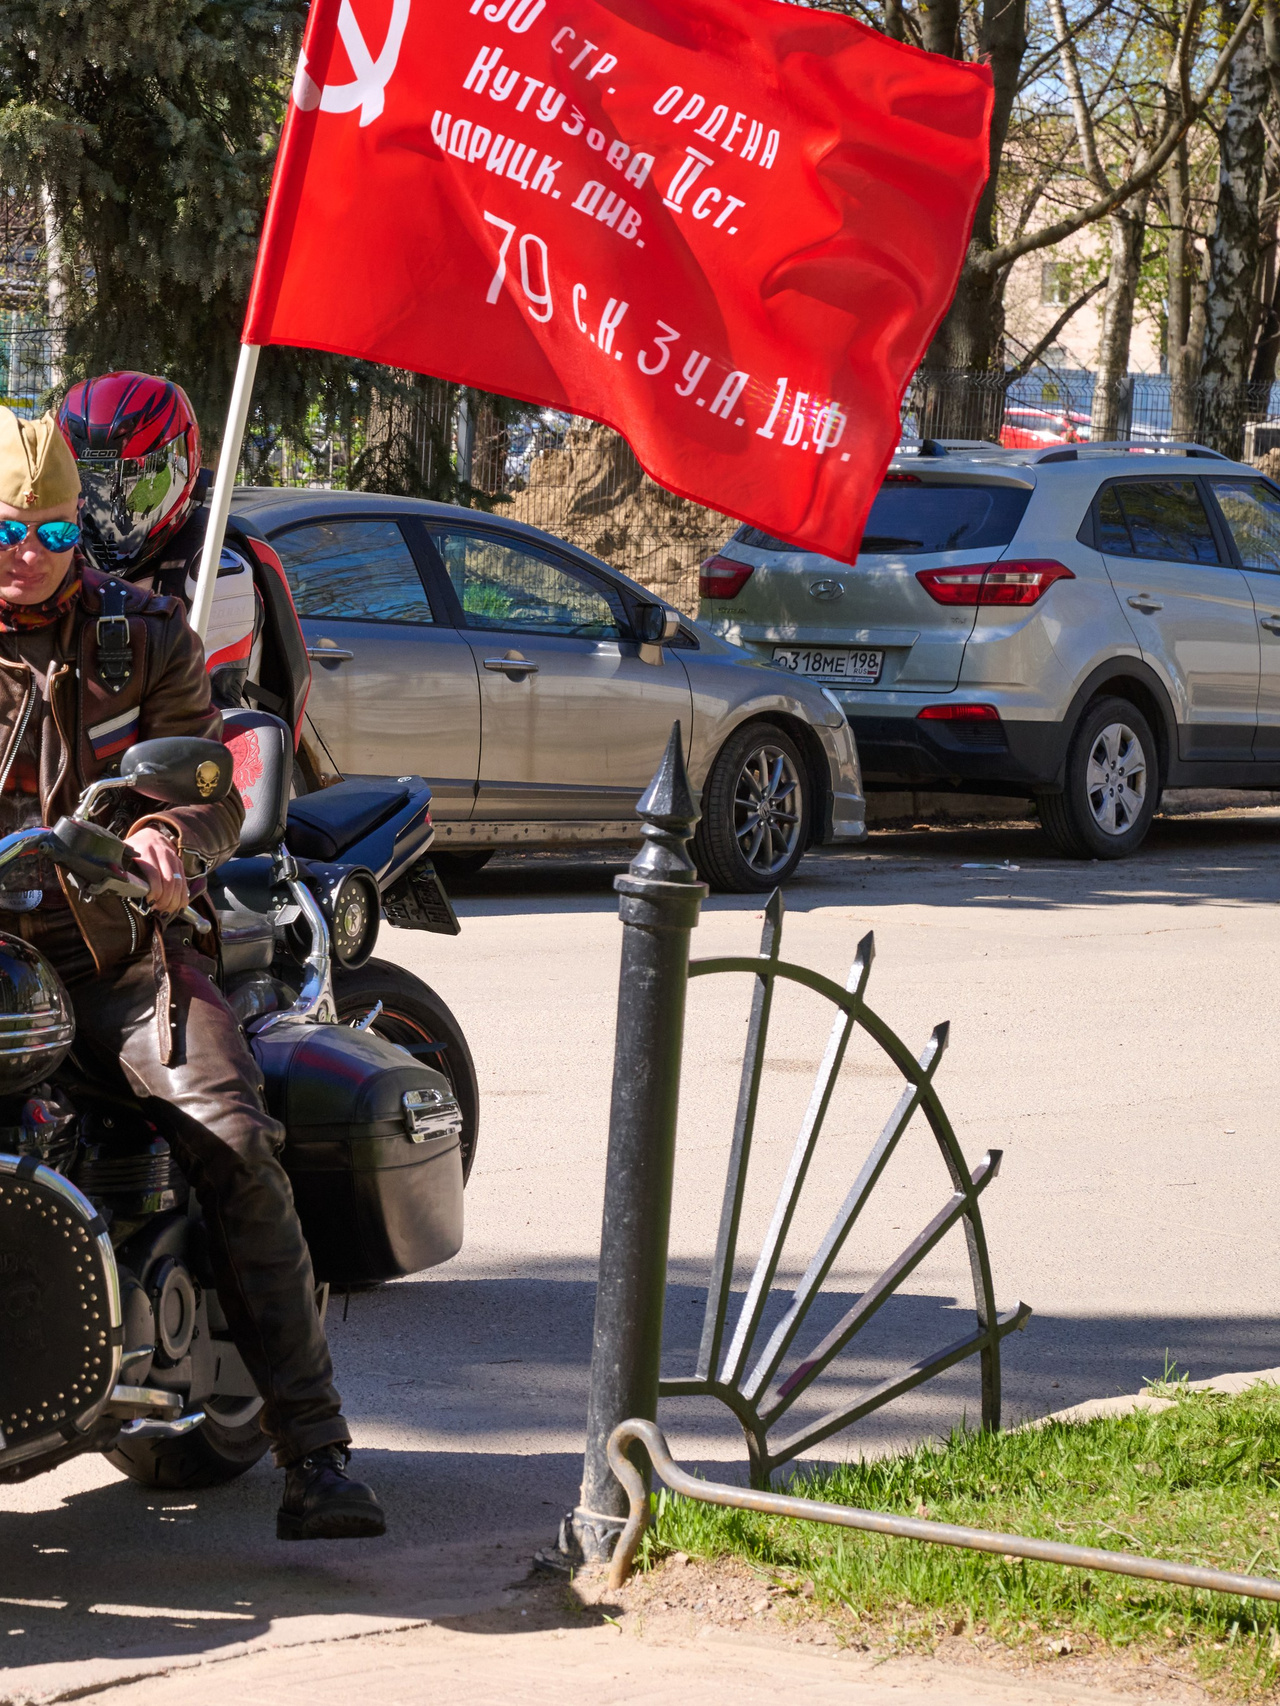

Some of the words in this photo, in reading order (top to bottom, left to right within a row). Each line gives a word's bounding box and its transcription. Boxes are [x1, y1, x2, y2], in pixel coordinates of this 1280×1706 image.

[652, 85, 780, 170] ОРДЕНА
[571, 180, 646, 249] ДИВ.
[483, 209, 554, 324] 79
[572, 282, 630, 361] С.К.
[851, 652, 877, 668] 198
[853, 667, 868, 675] RUS
